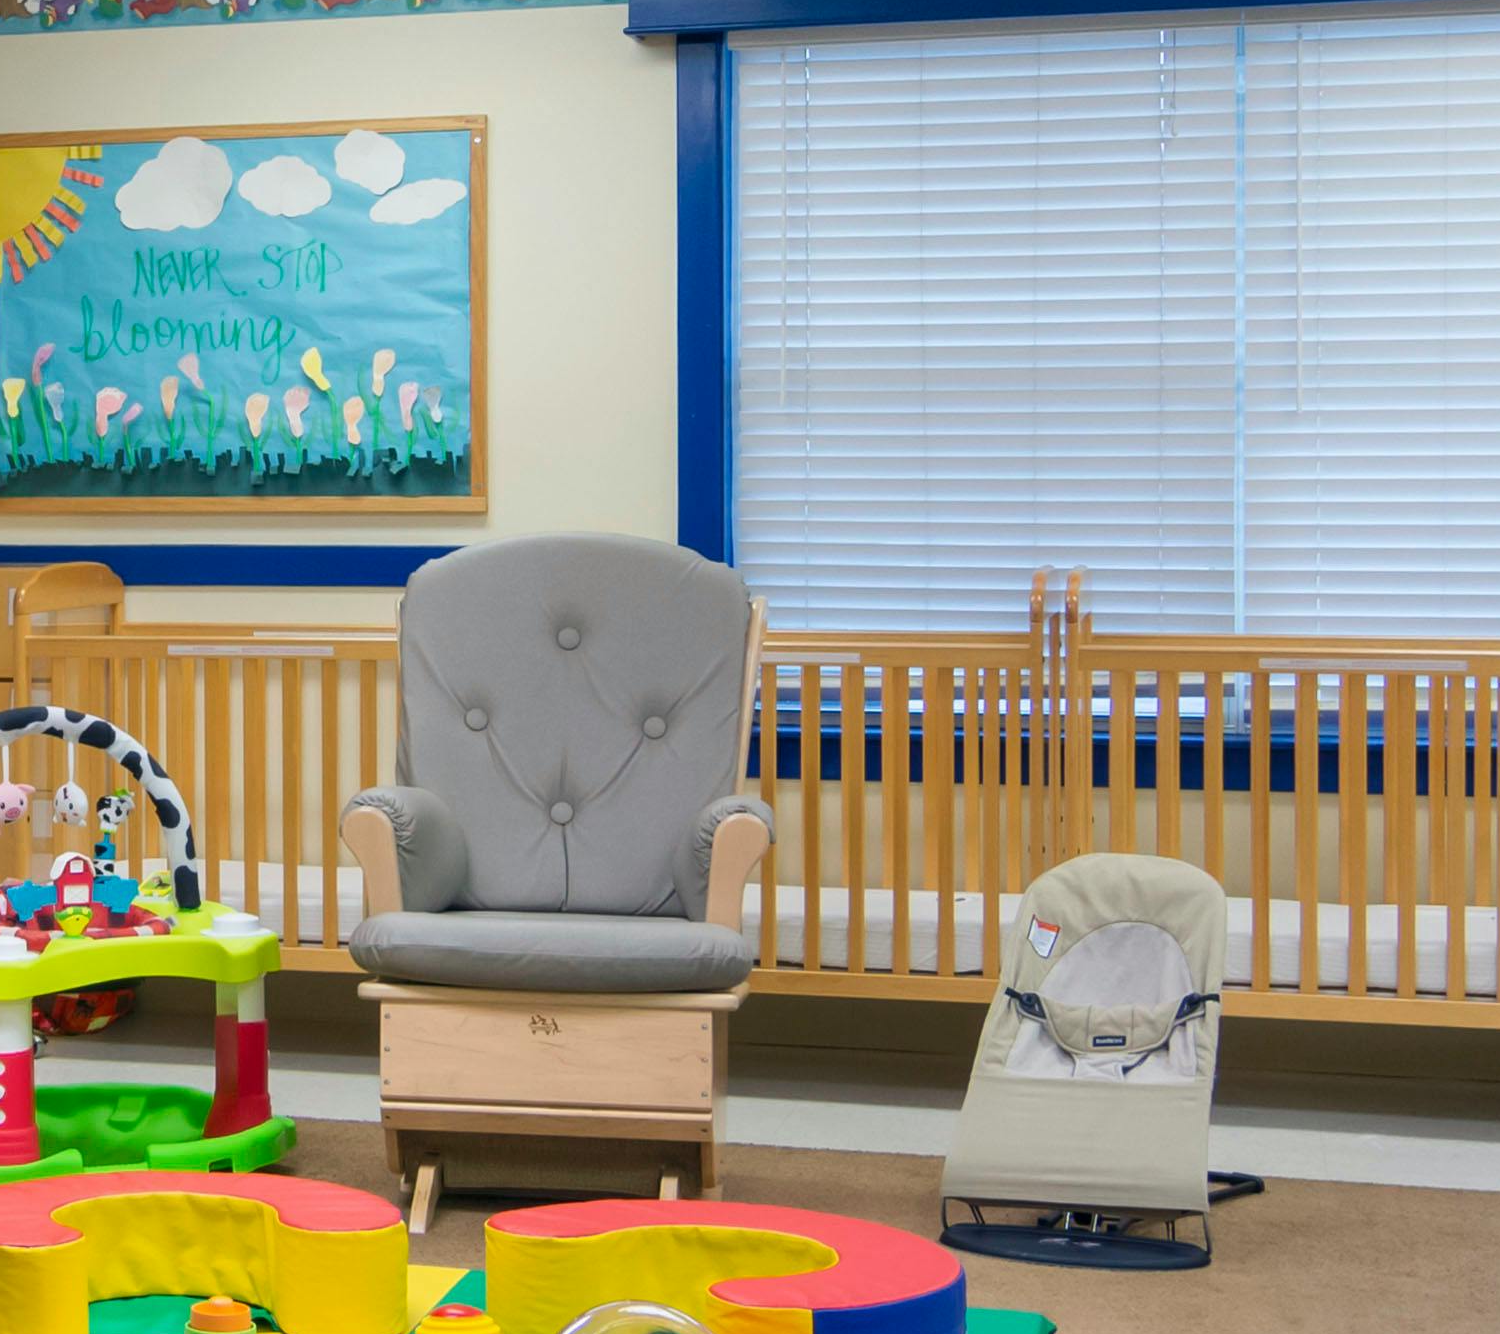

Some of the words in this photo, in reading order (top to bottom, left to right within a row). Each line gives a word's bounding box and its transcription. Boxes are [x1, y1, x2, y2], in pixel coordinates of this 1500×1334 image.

[132, 246, 248, 297] NEVER
[258, 240, 343, 293] STOP
[69, 294, 296, 385] blooming
